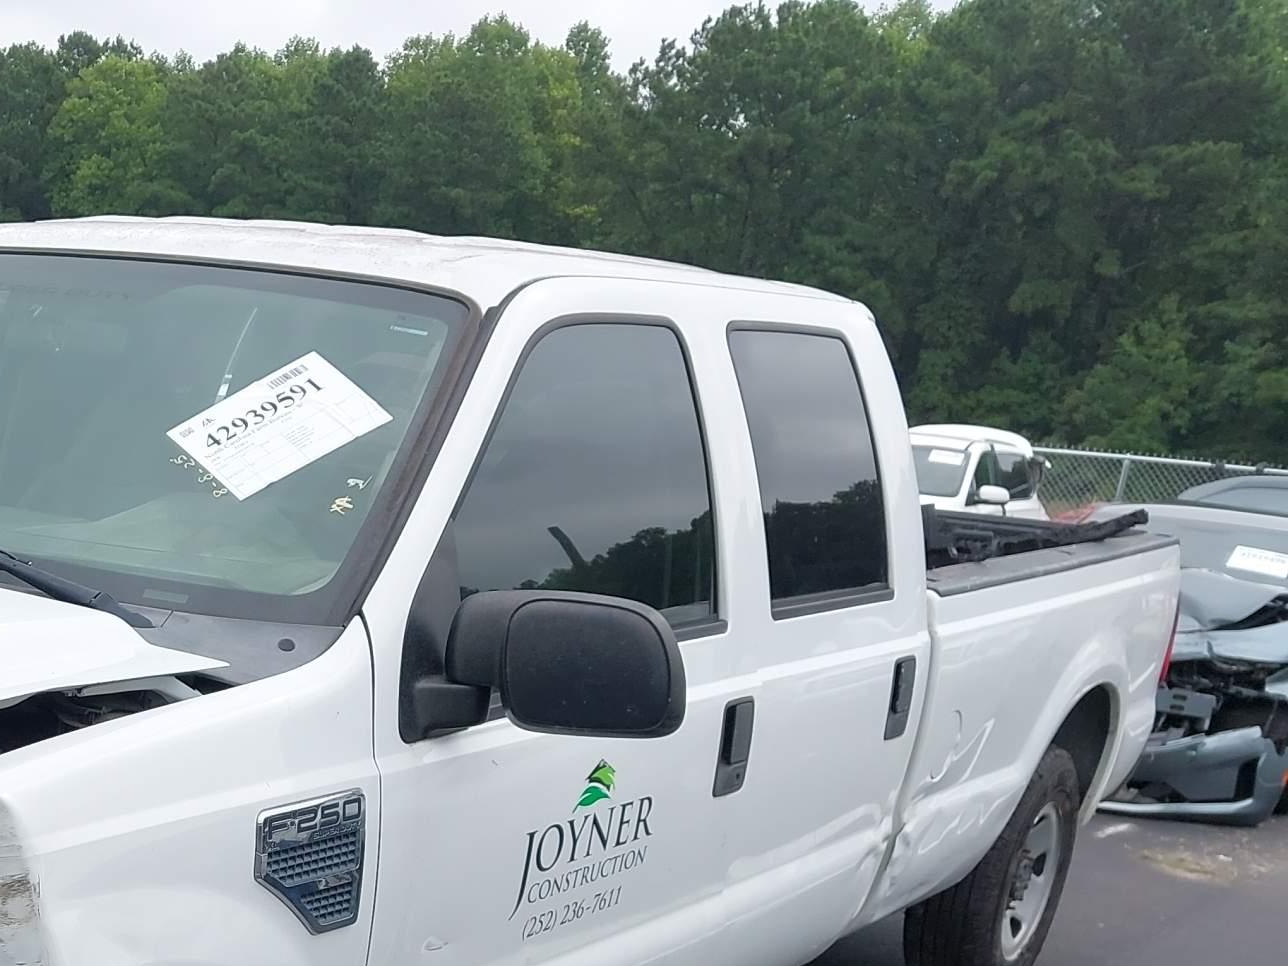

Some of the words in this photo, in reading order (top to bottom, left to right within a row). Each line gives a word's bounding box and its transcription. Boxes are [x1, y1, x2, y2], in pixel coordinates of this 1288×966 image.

[206, 378, 324, 447] 42939591
[508, 796, 654, 921] JOYNER
[527, 845, 648, 904] CONSTRUCTION
[521, 908, 558, 941] (252)
[559, 885, 622, 926] 236-7611
